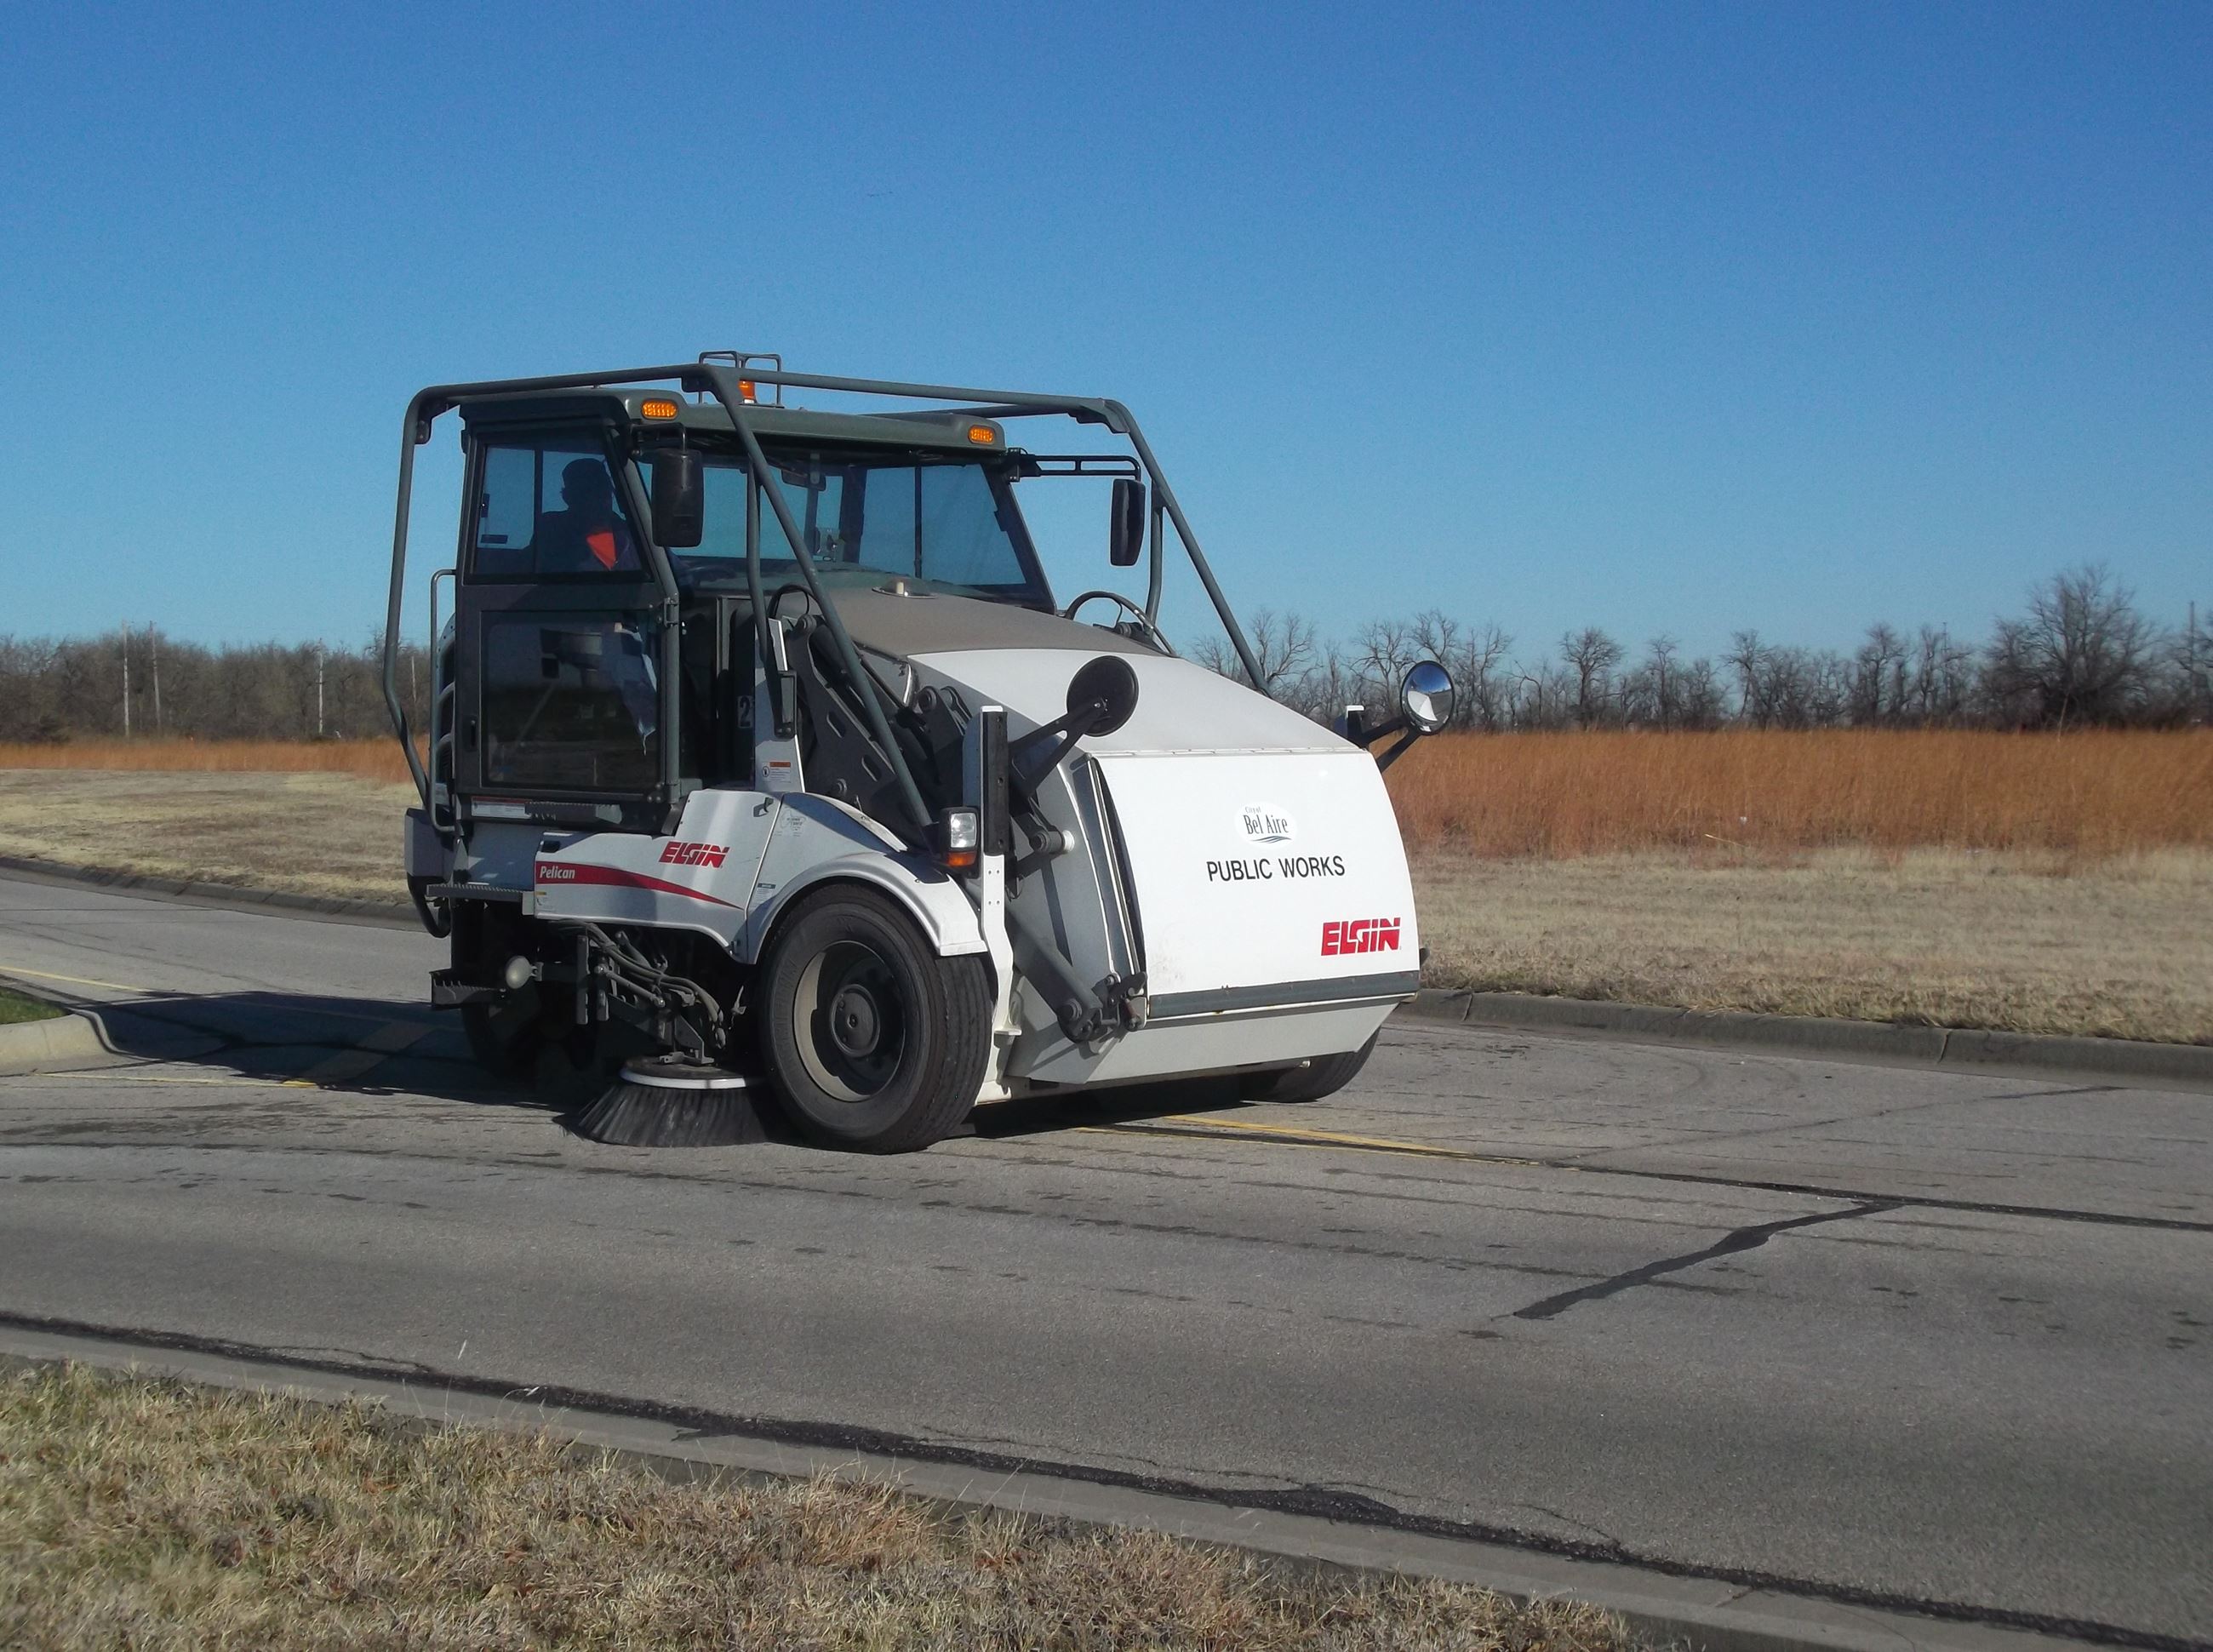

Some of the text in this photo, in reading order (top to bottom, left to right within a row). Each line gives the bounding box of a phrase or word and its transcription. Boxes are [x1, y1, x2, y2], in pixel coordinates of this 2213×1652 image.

[1243, 814, 1289, 835] Bel Aire
[659, 841, 730, 869] ELGIN
[1206, 855, 1346, 882] PUBLIC WORKS
[540, 866, 575, 879] Pelican
[1321, 917, 1401, 956] ELGIN
